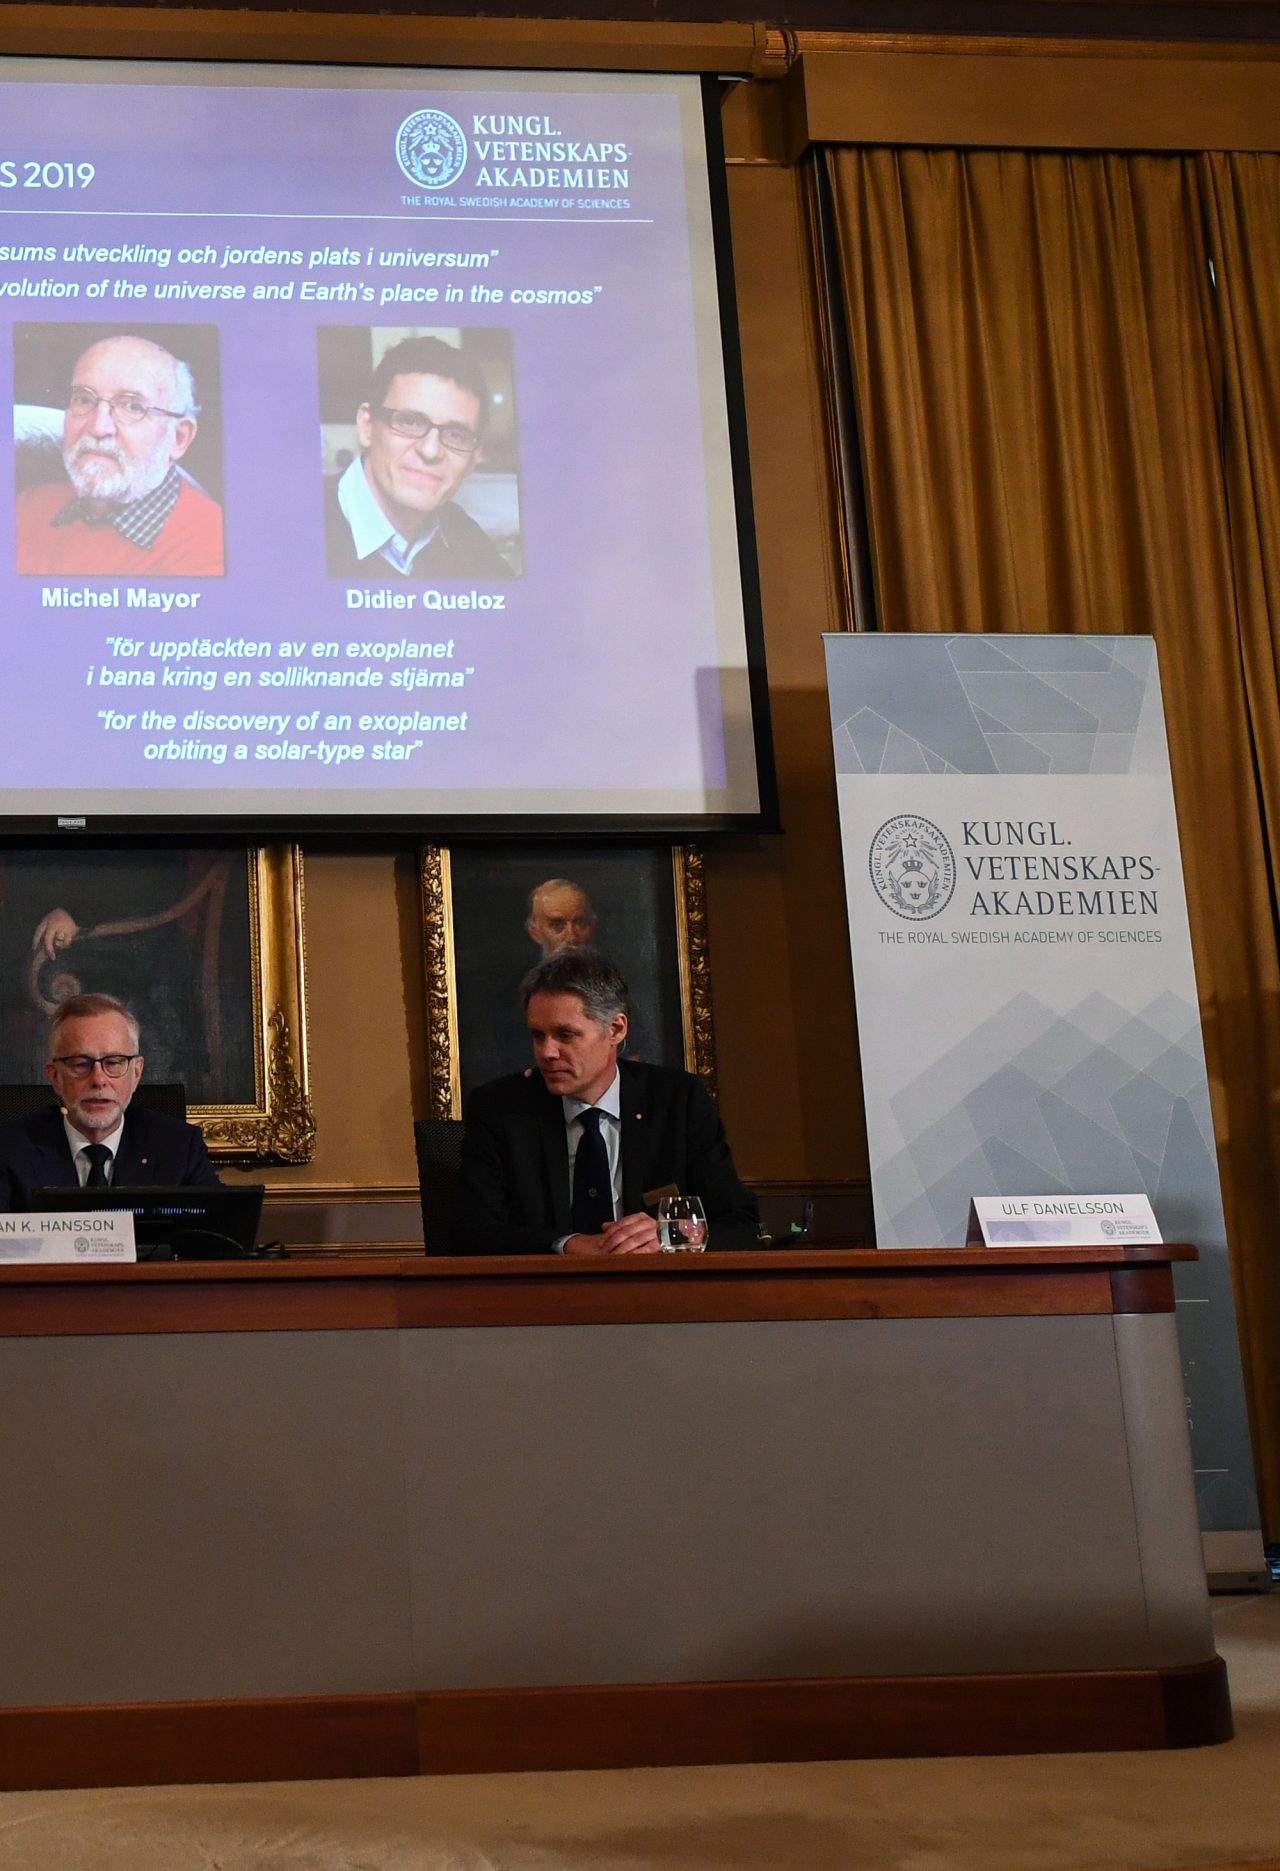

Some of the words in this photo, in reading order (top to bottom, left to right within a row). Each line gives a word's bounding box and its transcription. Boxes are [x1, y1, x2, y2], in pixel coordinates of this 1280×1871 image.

[473, 115, 562, 135] KUNGL.
[473, 141, 632, 162] VETENSKAPS-
[23, 162, 95, 188] 2019
[475, 167, 628, 188] AKADEMIEN
[400, 195, 421, 206] THE
[424, 196, 457, 206] ROYAL
[459, 197, 507, 207] SWEDISH
[509, 197, 559, 208] ACADEMY
[561, 198, 575, 208] OF
[577, 198, 631, 209] SCIENCES
[63, 244, 171, 267] utveckling
[178, 245, 217, 264] och
[220, 245, 303, 268] jordens
[308, 247, 361, 269] plats
[366, 247, 374, 266] i
[86, 279, 110, 298] of
[113, 280, 147, 298] the
[154, 280, 246, 299] universe
[252, 281, 295, 300] and
[379, 283, 439, 306] place
[445, 284, 464, 303] in
[470, 285, 504, 303] the
[42, 588, 119, 607] Michel
[127, 588, 201, 612] Mayor
[346, 589, 417, 609] Didier
[423, 590, 506, 610] Queloz
[149, 637, 271, 661] upptäckten
[278, 642, 306, 657] av
[312, 642, 339, 657] en
[346, 638, 455, 663] exoplanet
[86, 666, 94, 686] i
[99, 666, 155, 686] bana
[162, 666, 217, 691] kring
[224, 671, 251, 686] en
[258, 667, 383, 687] solliknande
[141, 710, 176, 730] the
[183, 710, 291, 735] discovery
[296, 711, 320, 730] of
[324, 715, 351, 730] an
[359, 711, 468, 735] exoplanet
[144, 739, 227, 764] orbiting
[233, 744, 248, 760] a
[254, 740, 365, 764] solar-type
[961, 822, 1071, 845] KUNGL.
[964, 856, 1160, 880] VETENSKAPS-
[970, 891, 1158, 915] AKADEMIEN
[878, 932, 904, 944] THE
[908, 932, 949, 944] ROYAL
[951, 931, 1010, 944] SWEDISH
[1014, 931, 1074, 943] ACADEMY
[1077, 931, 1094, 943] OF
[1098, 930, 1162, 943] SCIENCES
[1002, 1203, 1029, 1215] ULF
[1033, 1202, 1124, 1215] DANIELSSON
[22, 1220, 36, 1233] K.
[41, 1220, 114, 1231] HANSSON
